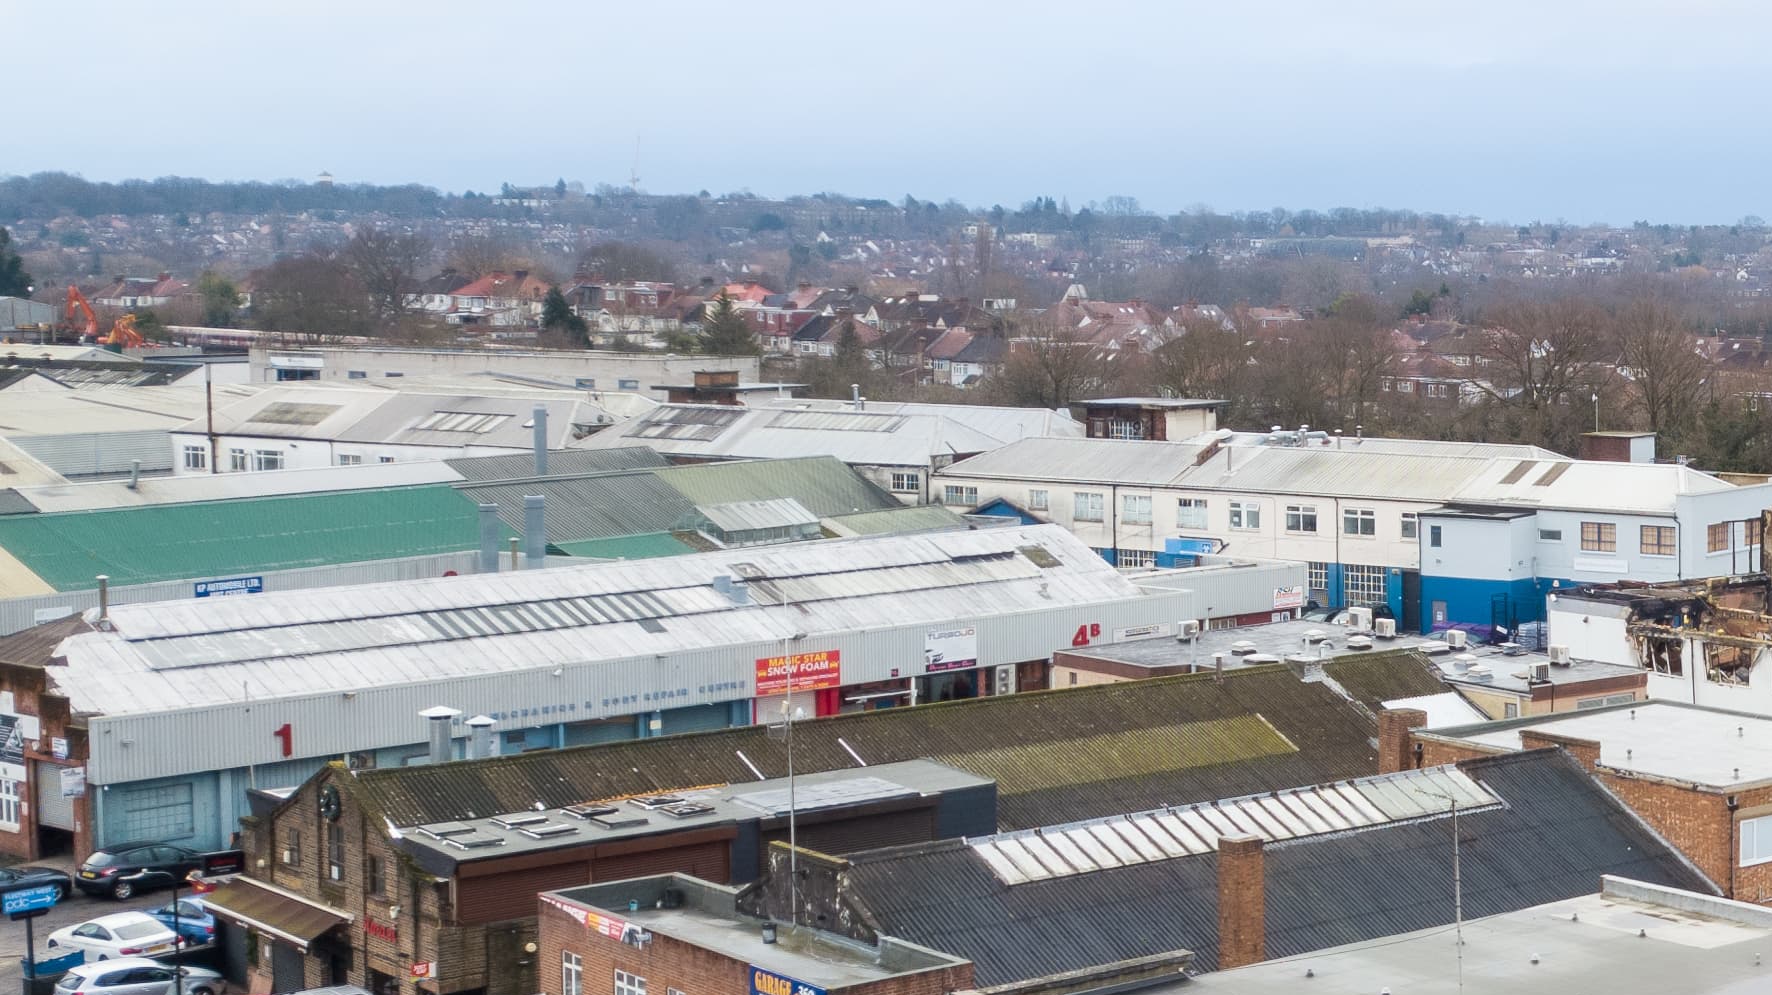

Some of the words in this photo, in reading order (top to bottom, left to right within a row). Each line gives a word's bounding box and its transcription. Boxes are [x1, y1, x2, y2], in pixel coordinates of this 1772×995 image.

[804, 652, 828, 661] STAR
[768, 665, 797, 677] SNOW
[800, 660, 829, 672] FOAM
[273, 723, 292, 757] 1
